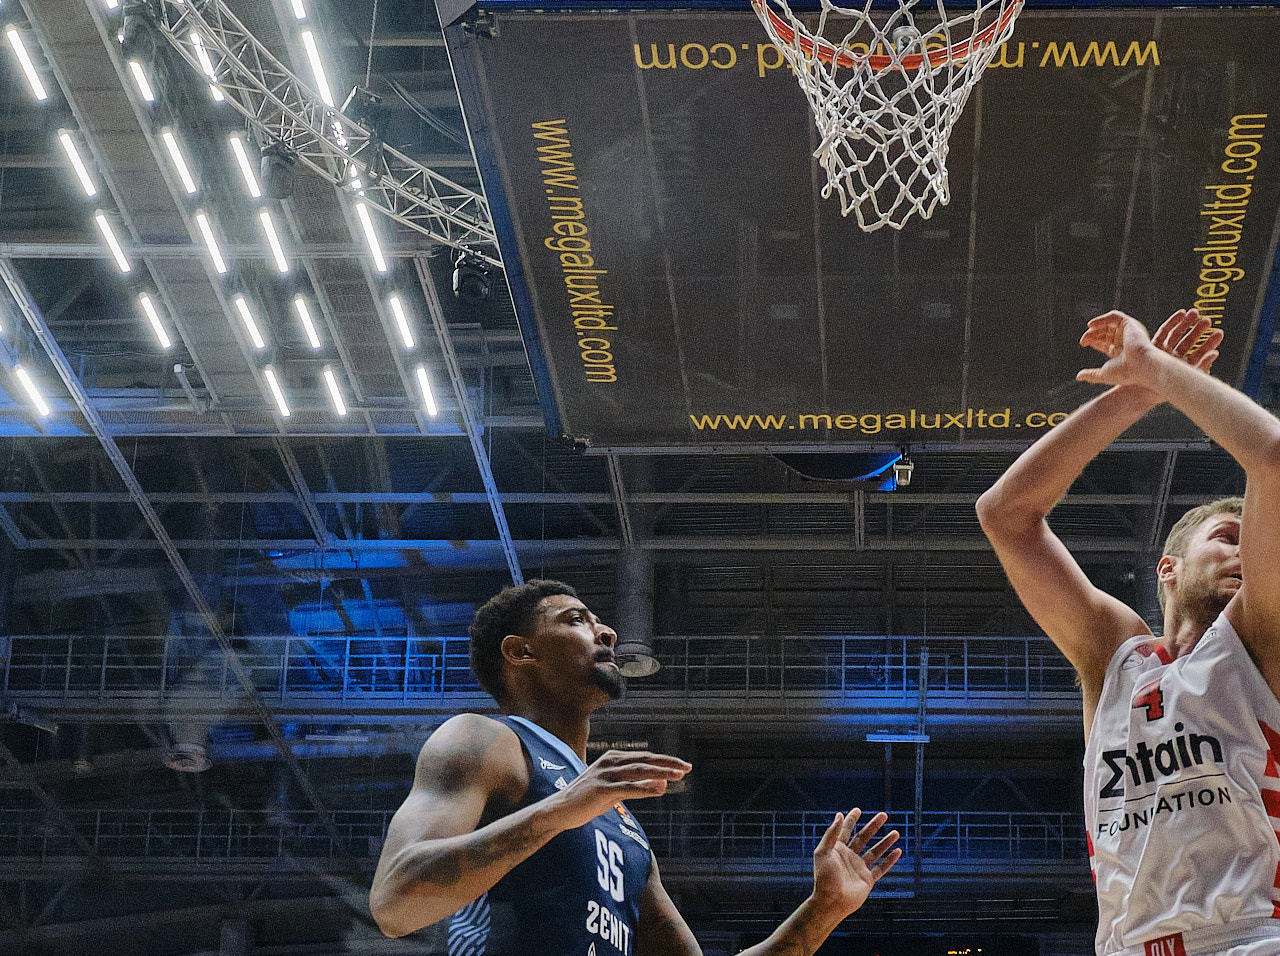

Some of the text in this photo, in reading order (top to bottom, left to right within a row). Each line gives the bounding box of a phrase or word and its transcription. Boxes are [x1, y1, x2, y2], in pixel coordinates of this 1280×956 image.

[531, 119, 619, 384] www.megaluxltd.com
[690, 408, 1069, 435] www.megaluxltd.co
[1097, 787, 1232, 840] FOUNATION
[586, 900, 630, 956] ZENIT
